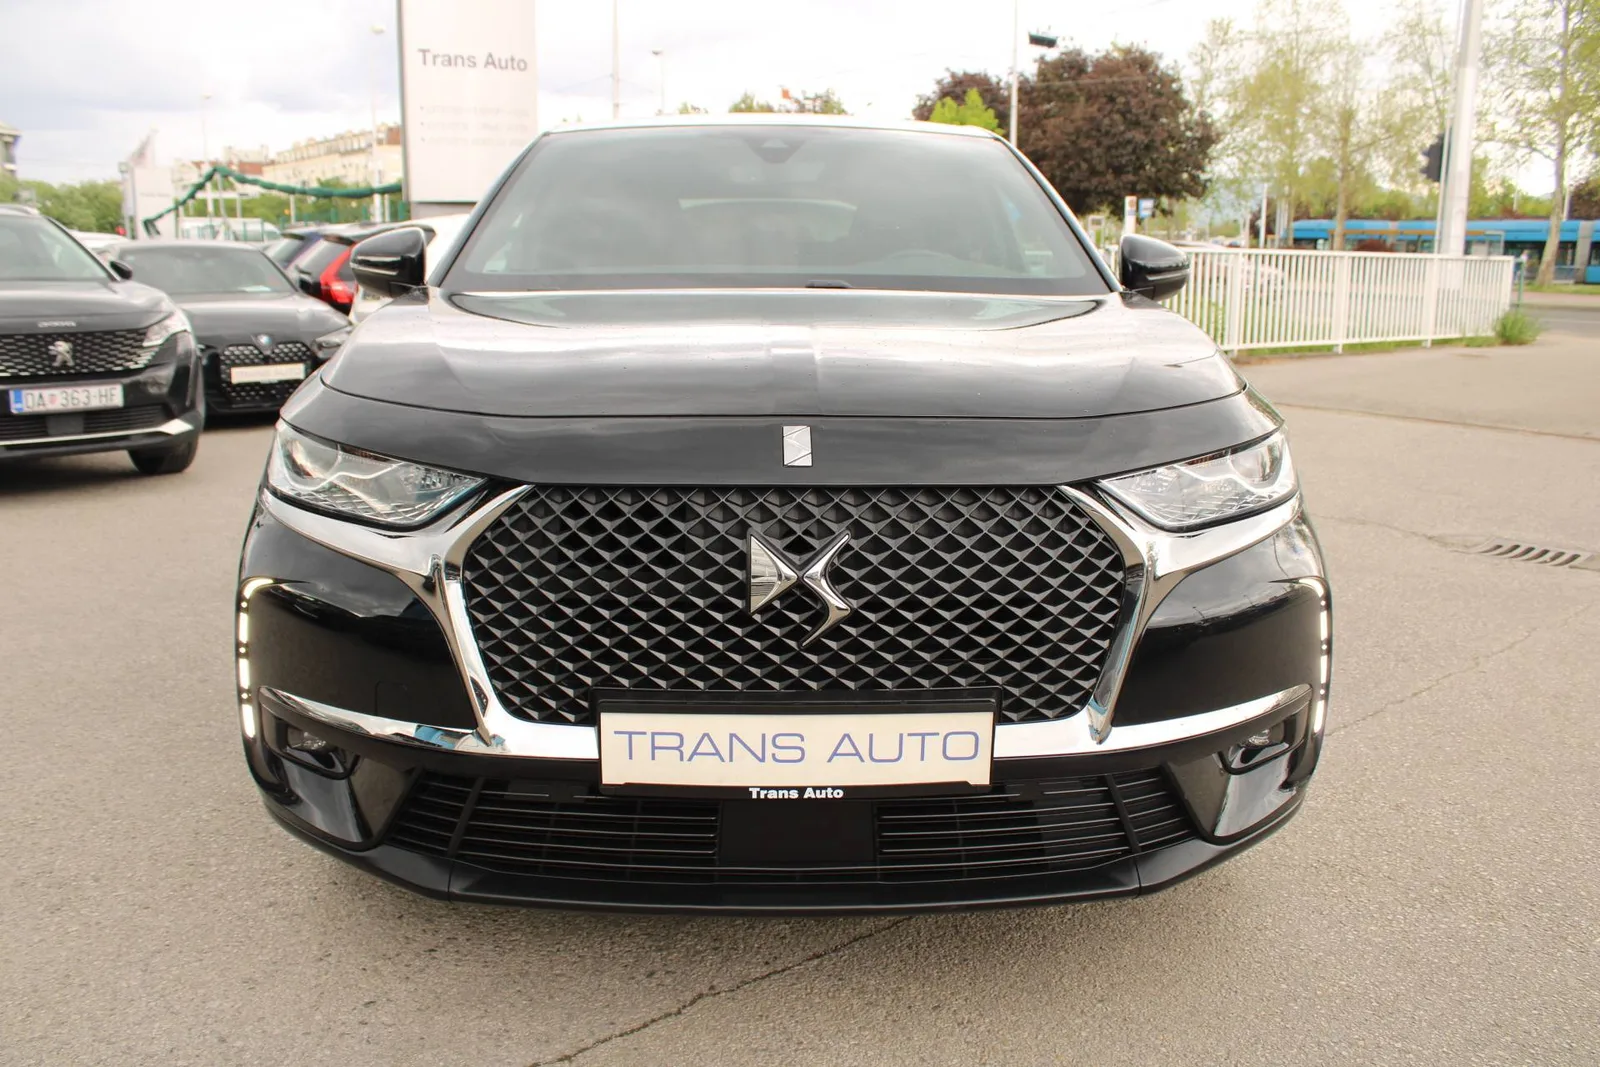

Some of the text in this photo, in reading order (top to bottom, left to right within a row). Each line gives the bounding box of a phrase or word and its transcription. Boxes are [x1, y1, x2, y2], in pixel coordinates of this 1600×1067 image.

[417, 48, 528, 72] Trans Auto
[613, 730, 980, 764] TRANS AUTO
[749, 787, 845, 800] Trans Auto
